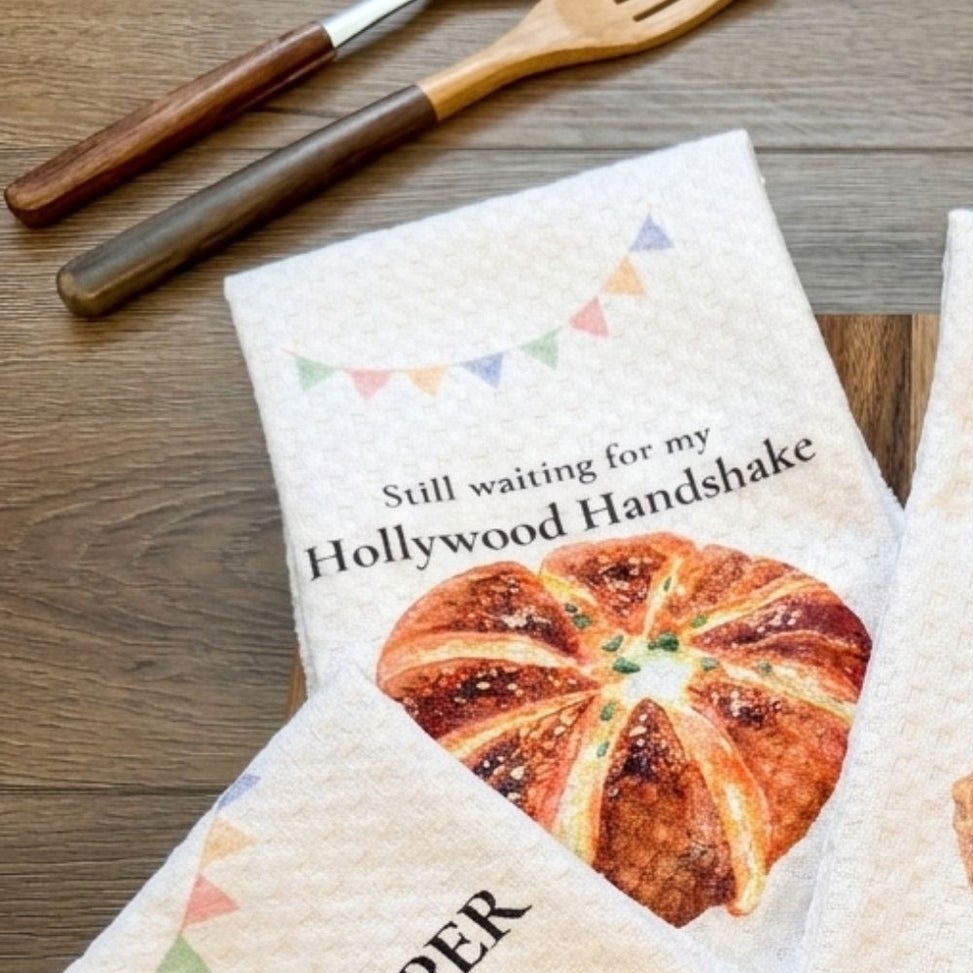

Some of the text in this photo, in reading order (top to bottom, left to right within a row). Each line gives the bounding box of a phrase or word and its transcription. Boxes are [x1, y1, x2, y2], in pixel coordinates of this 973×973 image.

[306, 435, 817, 581] Hollywood Handshake
[382, 427, 710, 508] Still waiting for my
